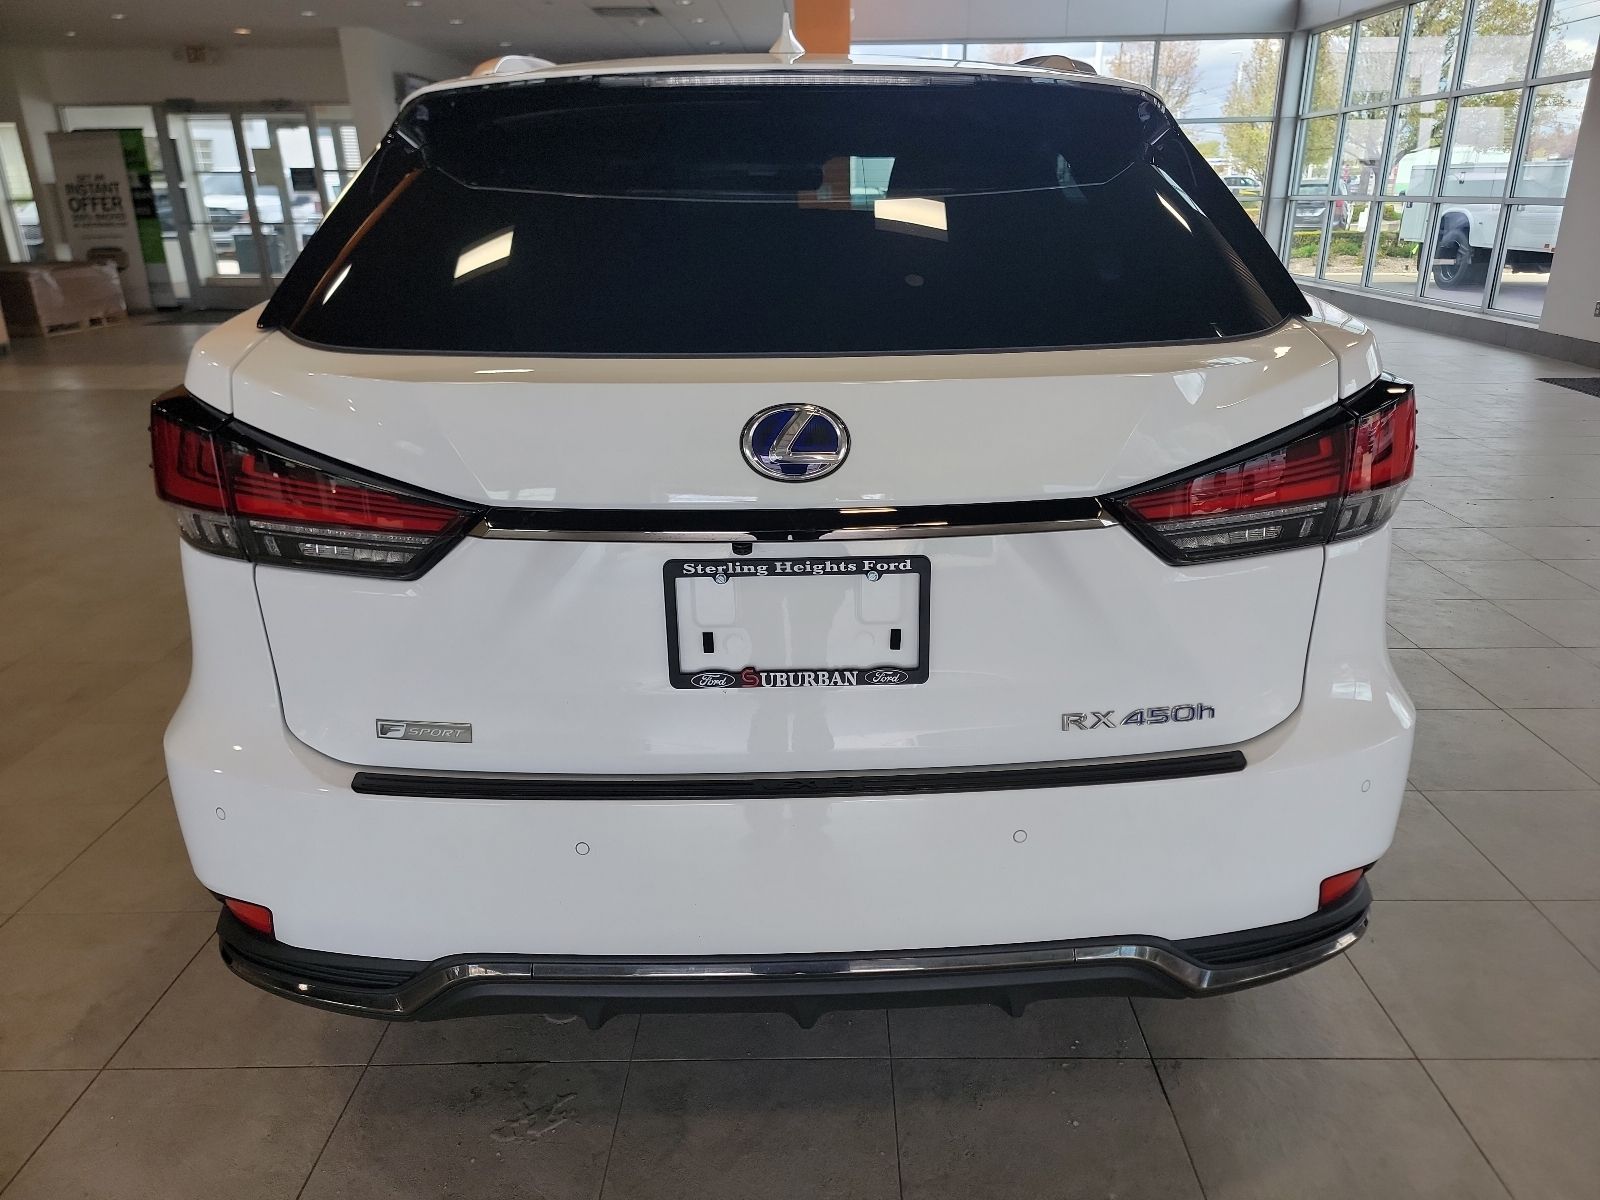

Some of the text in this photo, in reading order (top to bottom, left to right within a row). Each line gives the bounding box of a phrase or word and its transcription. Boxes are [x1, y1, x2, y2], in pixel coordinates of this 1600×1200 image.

[68, 196, 124, 212] OFFER
[682, 559, 913, 576] Sterling Heights Ford
[741, 667, 859, 688] SUBURBAN
[1061, 703, 1216, 731] RX 450h
[408, 727, 465, 738] SPORT
